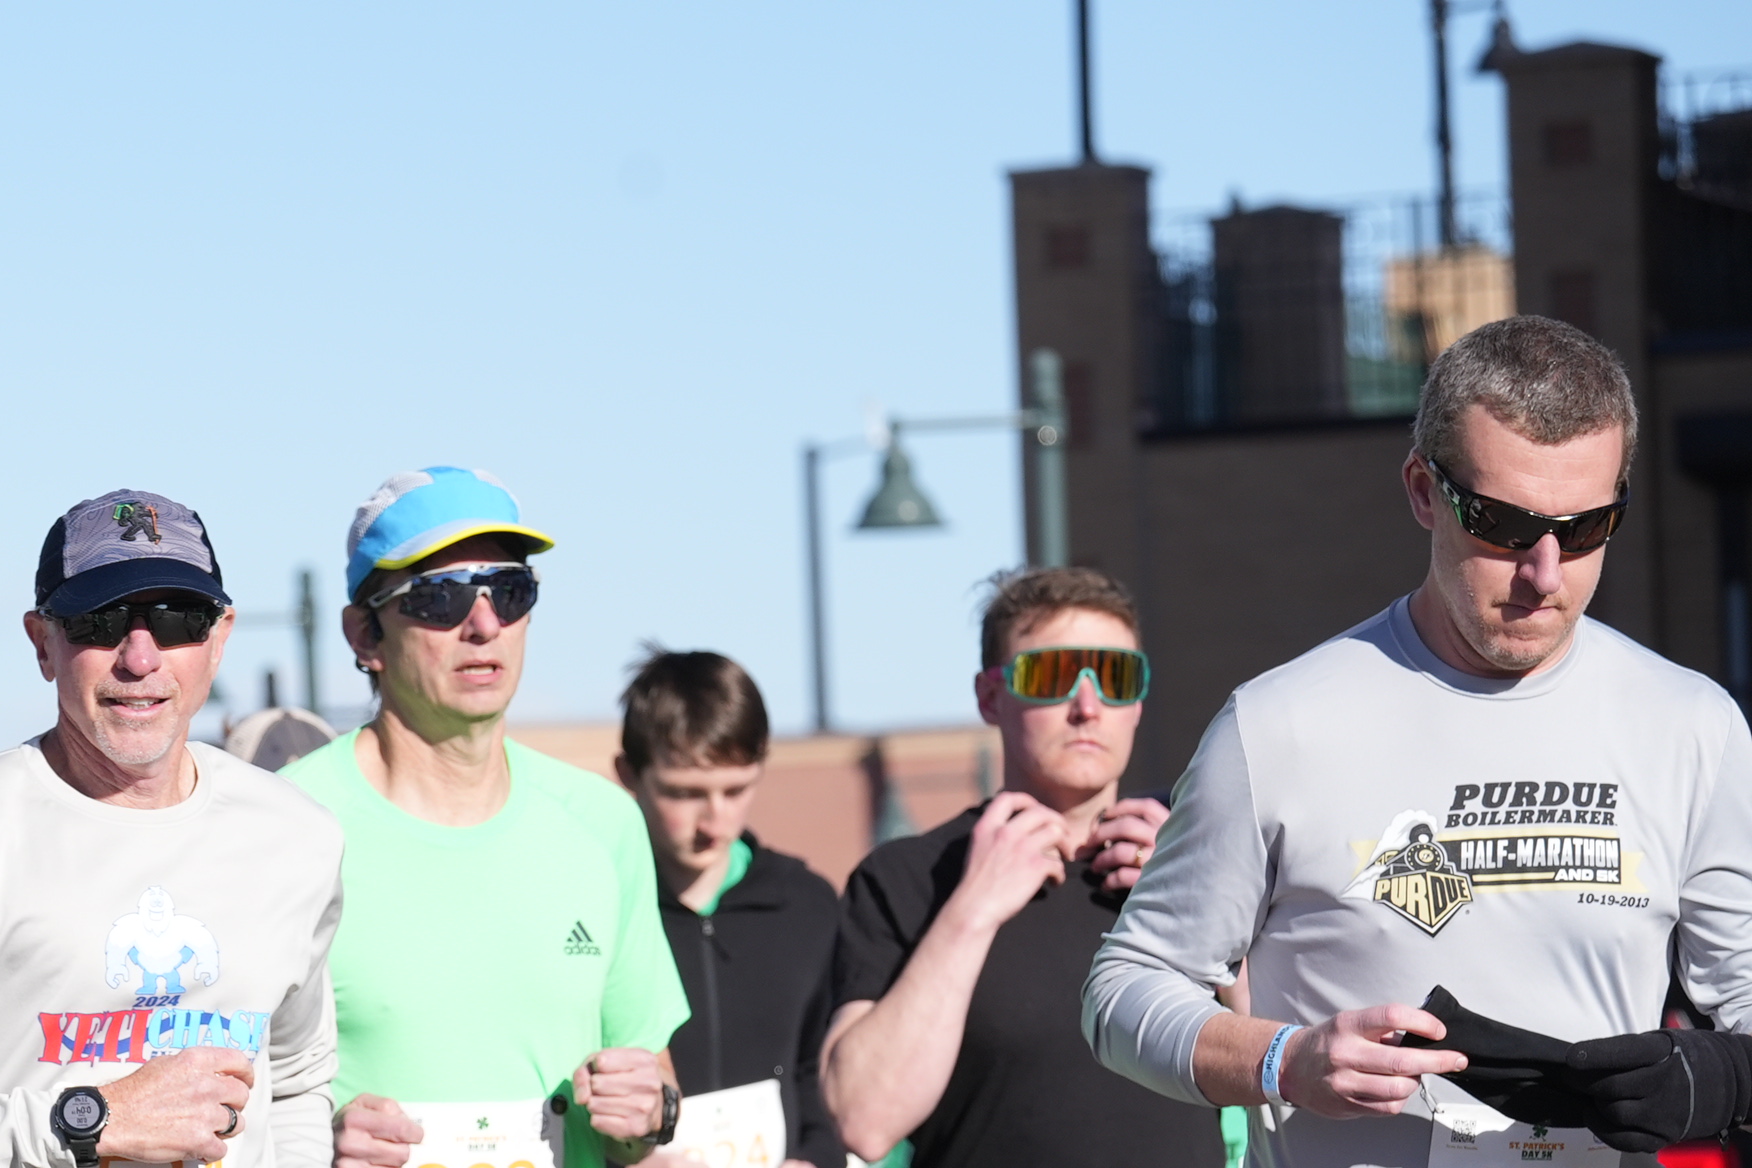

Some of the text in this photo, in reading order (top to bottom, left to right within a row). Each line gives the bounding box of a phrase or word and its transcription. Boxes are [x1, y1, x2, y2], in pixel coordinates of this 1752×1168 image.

[1449, 781, 1619, 811] PURDUE
[1444, 809, 1615, 828] BOILERMAKER
[1460, 838, 1619, 871] HALF-MARATHON
[1554, 869, 1620, 883] AND 5K
[1375, 872, 1470, 927] PURDUE
[1577, 893, 1650, 909] 10-19-2013
[133, 995, 180, 1008] 2024
[38, 1008, 153, 1067] YETI
[1521, 1150, 1540, 1158] DAY
